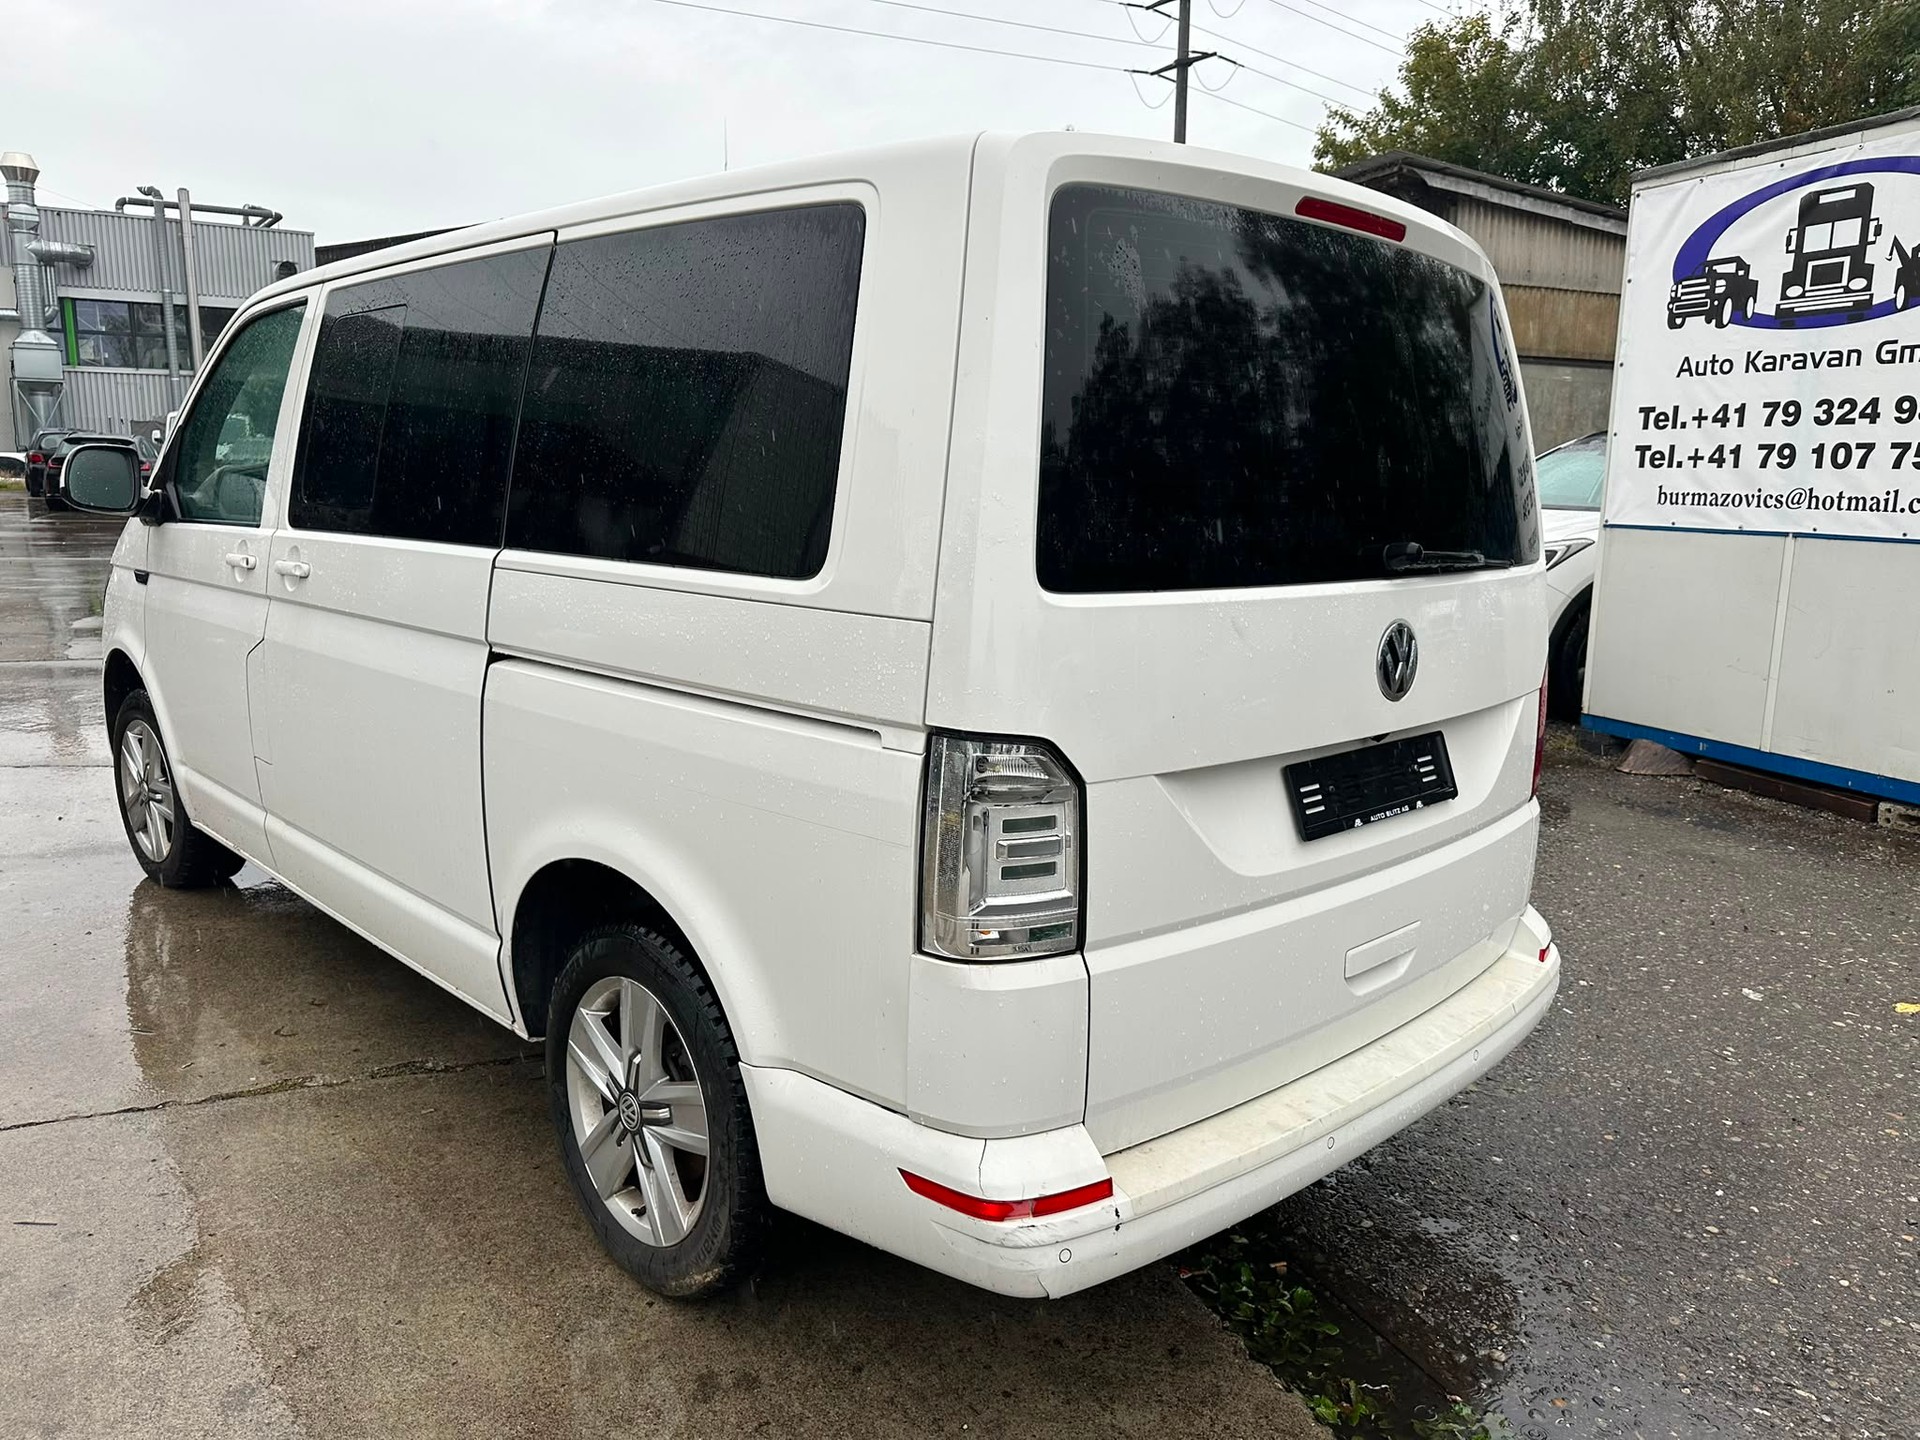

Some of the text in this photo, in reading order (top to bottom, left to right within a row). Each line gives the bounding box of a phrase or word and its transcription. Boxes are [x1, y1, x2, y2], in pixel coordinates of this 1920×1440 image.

[1675, 353, 1735, 378] Auto
[1744, 348, 1863, 374] Karavan
[1638, 394, 1920, 431] Tel.+41 79 324 9
[1634, 443, 1742, 470] Tel.+41
[1757, 442, 1797, 470] 79
[1811, 441, 1876, 470] 107
[1656, 484, 1920, 515] burmazovics@hotmail.c
[1370, 812, 1386, 822] AUTO
